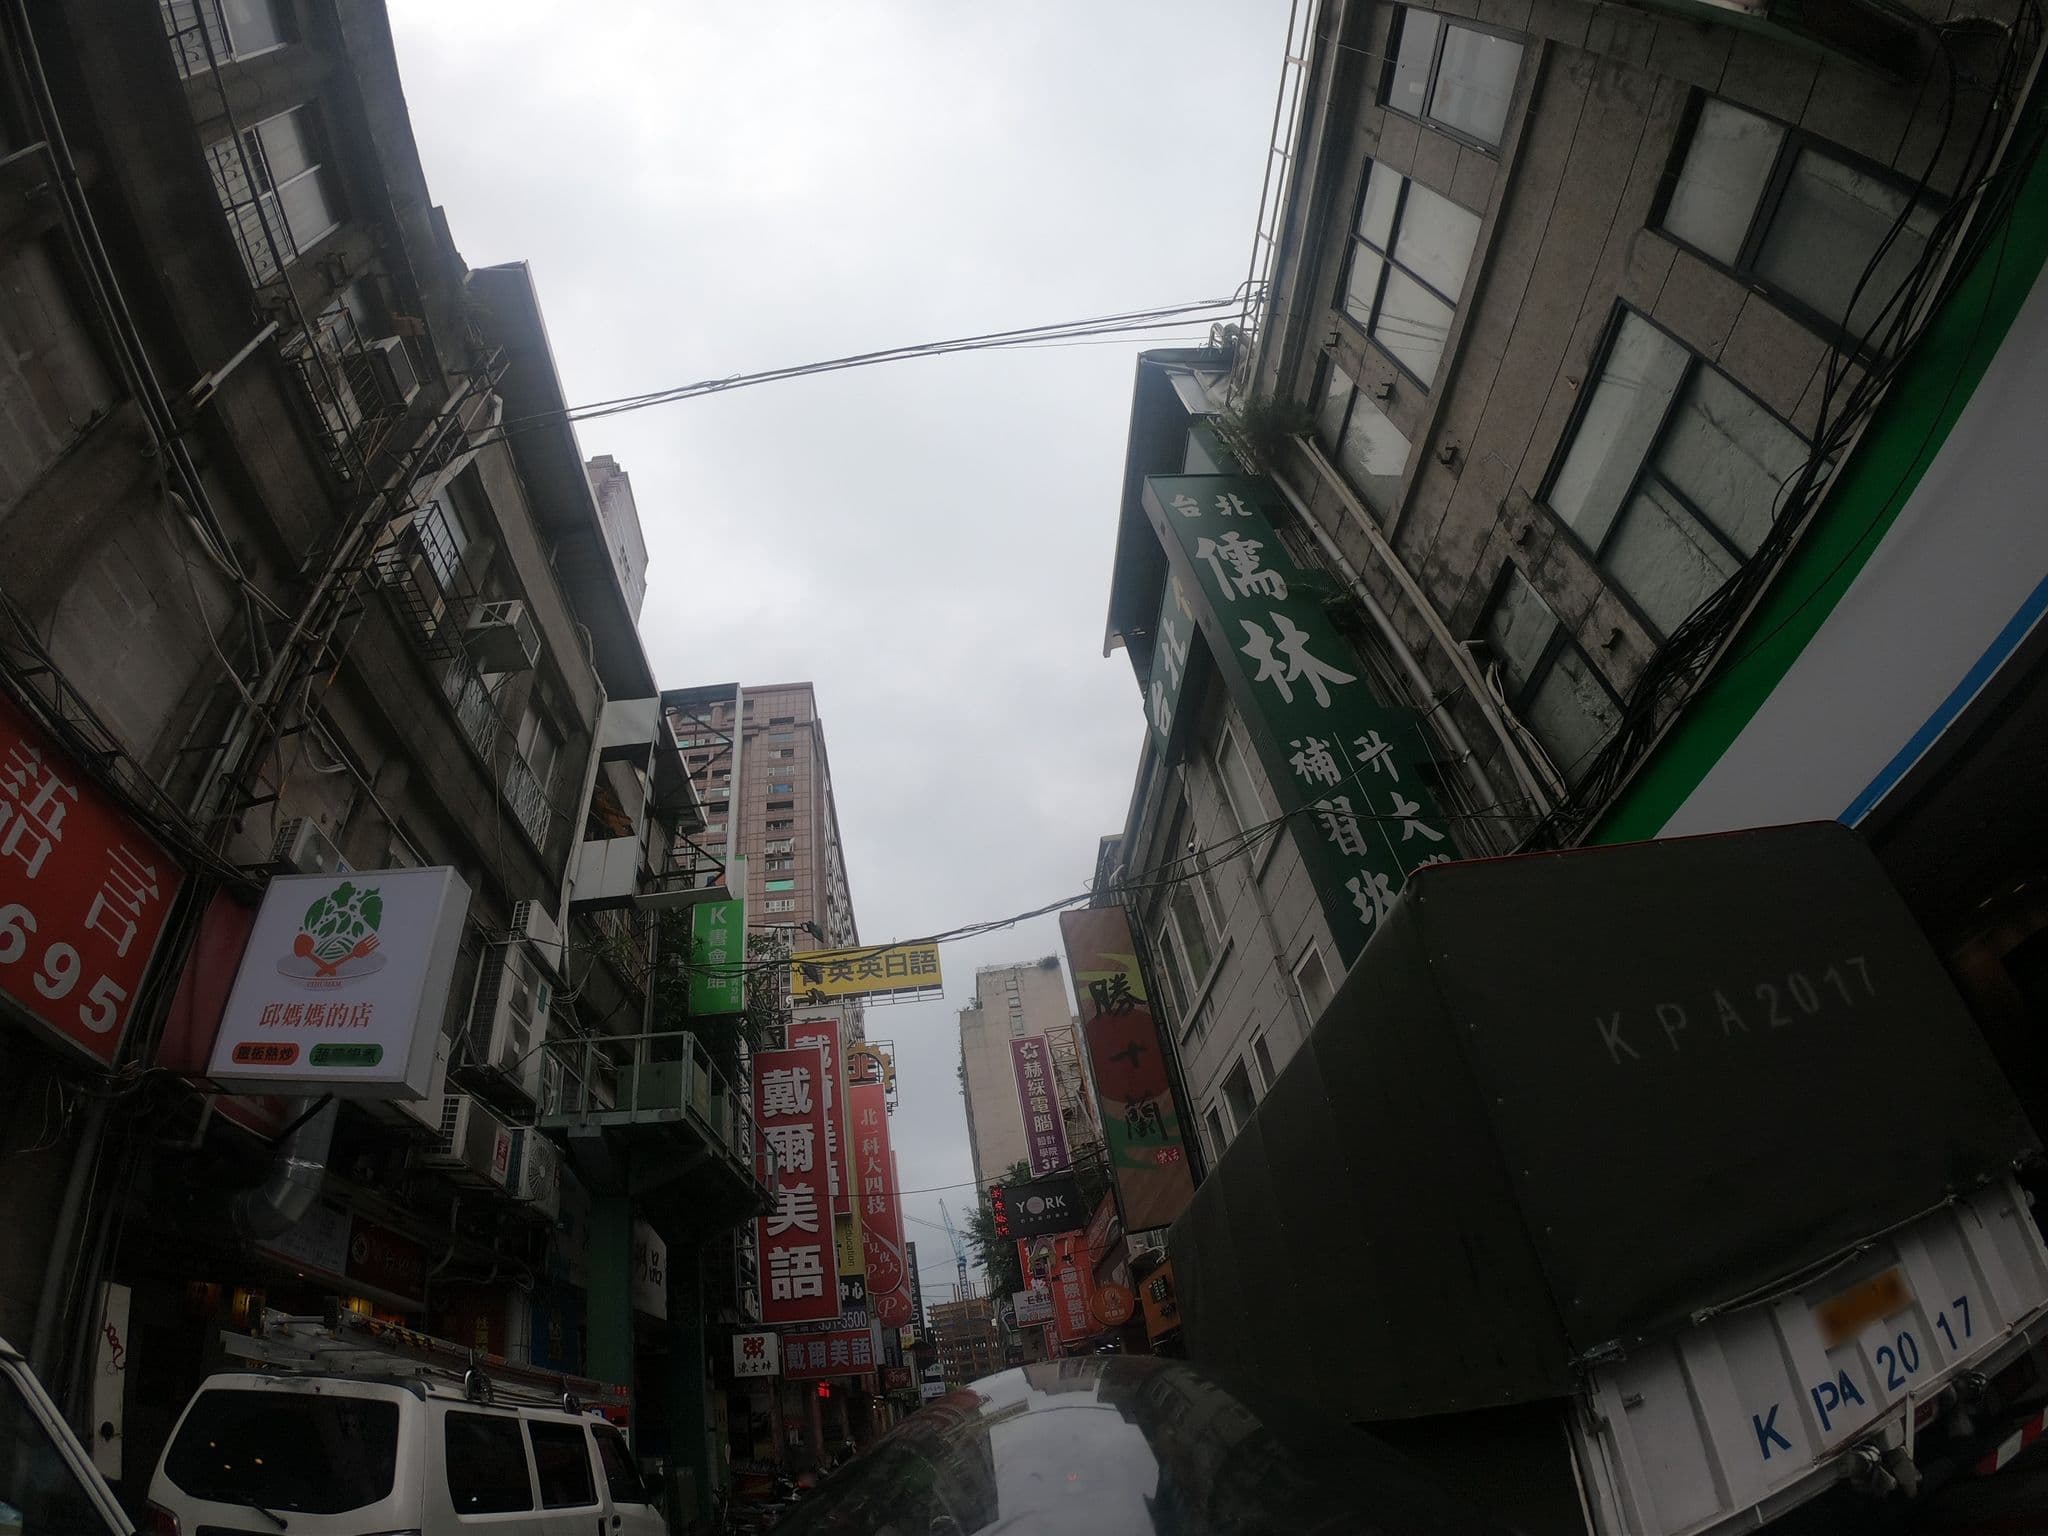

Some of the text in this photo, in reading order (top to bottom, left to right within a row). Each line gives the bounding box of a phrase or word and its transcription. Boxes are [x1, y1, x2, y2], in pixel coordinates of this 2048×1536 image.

[1169, 493, 1253, 518] 台北
[1196, 531, 1358, 709] 儒林
[1290, 735, 1400, 927] 補習班
[259, 1002, 374, 1028] 邱媽媽的店
[761, 1066, 824, 1300] 戴爾美語
[1016, 1195, 1067, 1214] YORK
[840, 1281, 864, 1301] 中心
[785, 1337, 873, 1370] 戴爾美語
